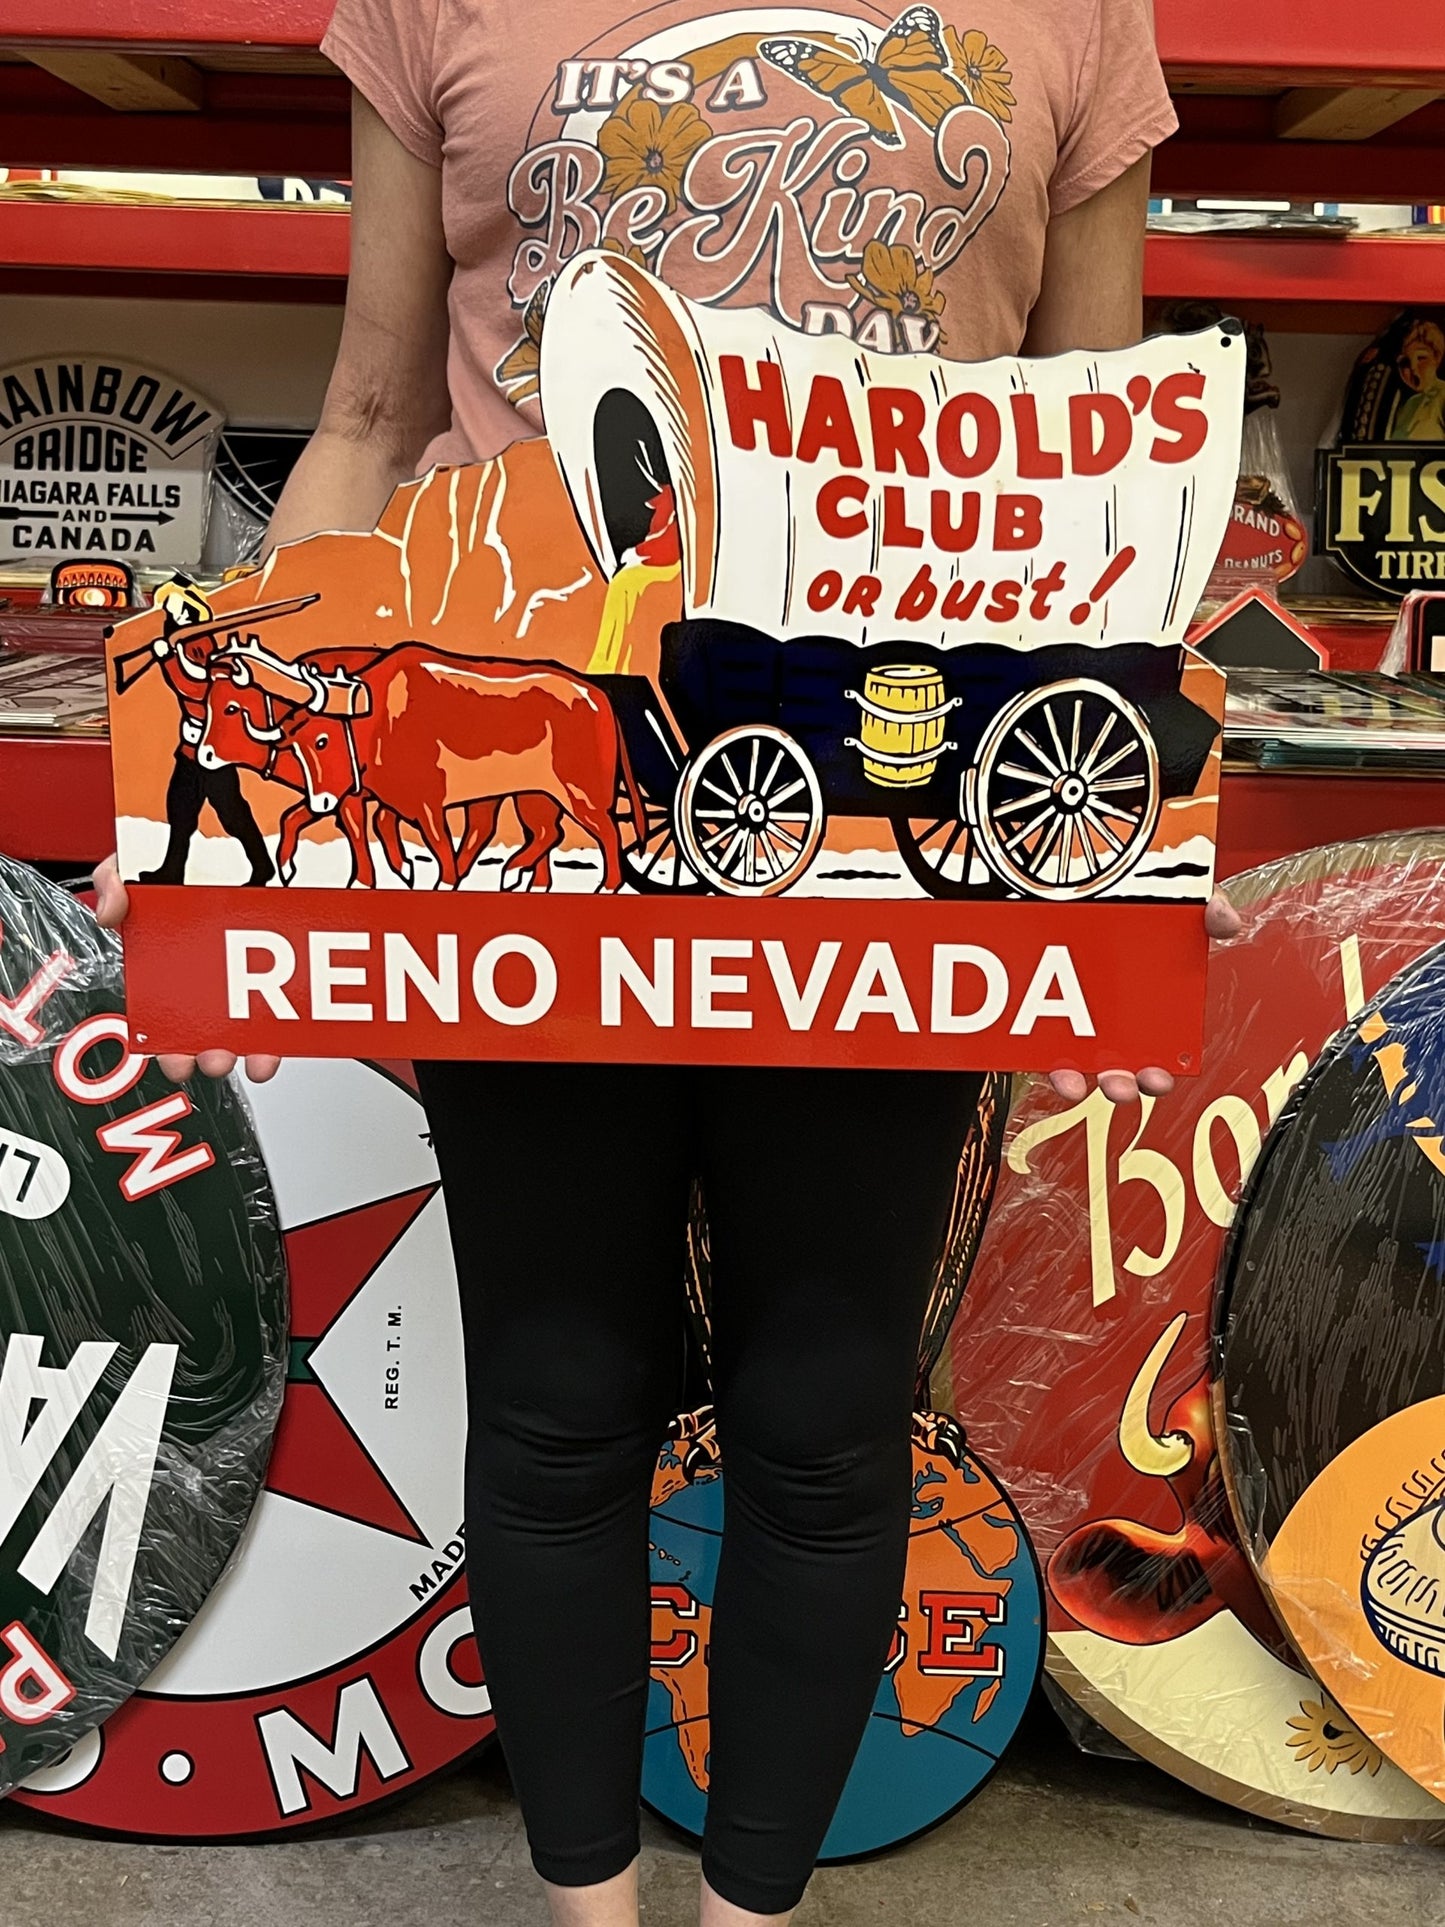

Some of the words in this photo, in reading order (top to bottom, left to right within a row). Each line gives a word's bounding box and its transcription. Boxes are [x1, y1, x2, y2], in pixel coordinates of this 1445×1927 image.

[553, 59, 695, 112] IT'S
[706, 57, 768, 112] A
[508, 138, 672, 305] Be
[656, 104, 1012, 328] Kind
[717, 354, 1209, 480] HAROLD'S
[13, 425, 149, 474] BRIDGE
[0, 479, 100, 506] IAGARA
[106, 482, 181, 509] FALLS
[61, 508, 108, 523] AND
[815, 475, 1043, 553] CLUB
[12, 524, 156, 553] CANADA
[1229, 504, 1281, 538] RAND
[223, 928, 558, 1025] RENO
[599, 934, 1097, 1038] NEVADA
[384, 1360, 400, 1410] REG.
